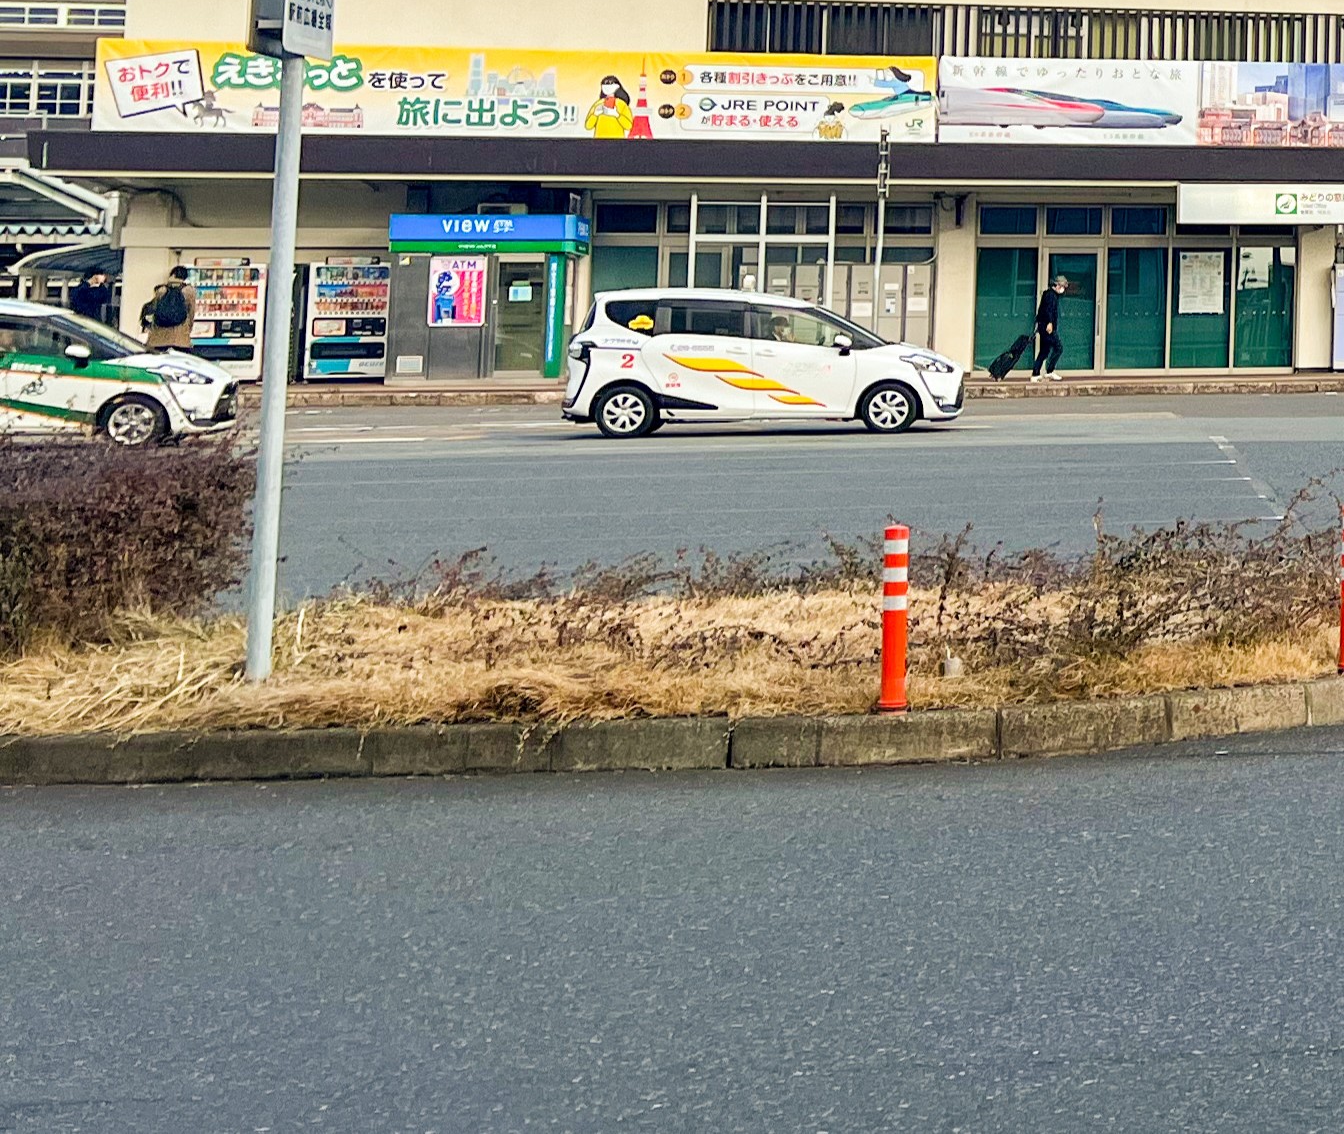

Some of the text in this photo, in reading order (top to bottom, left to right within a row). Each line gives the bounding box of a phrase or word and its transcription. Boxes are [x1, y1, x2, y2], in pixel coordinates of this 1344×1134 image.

[117, 59, 190, 83] おトクで
[368, 72, 446, 89] を使って
[130, 80, 183, 102] 便利!!
[397, 96, 576, 128] 旅に出よう!!
[721, 99, 820, 112] JRE POINT
[905, 118, 923, 128] JR
[620, 354, 634, 369] 2
